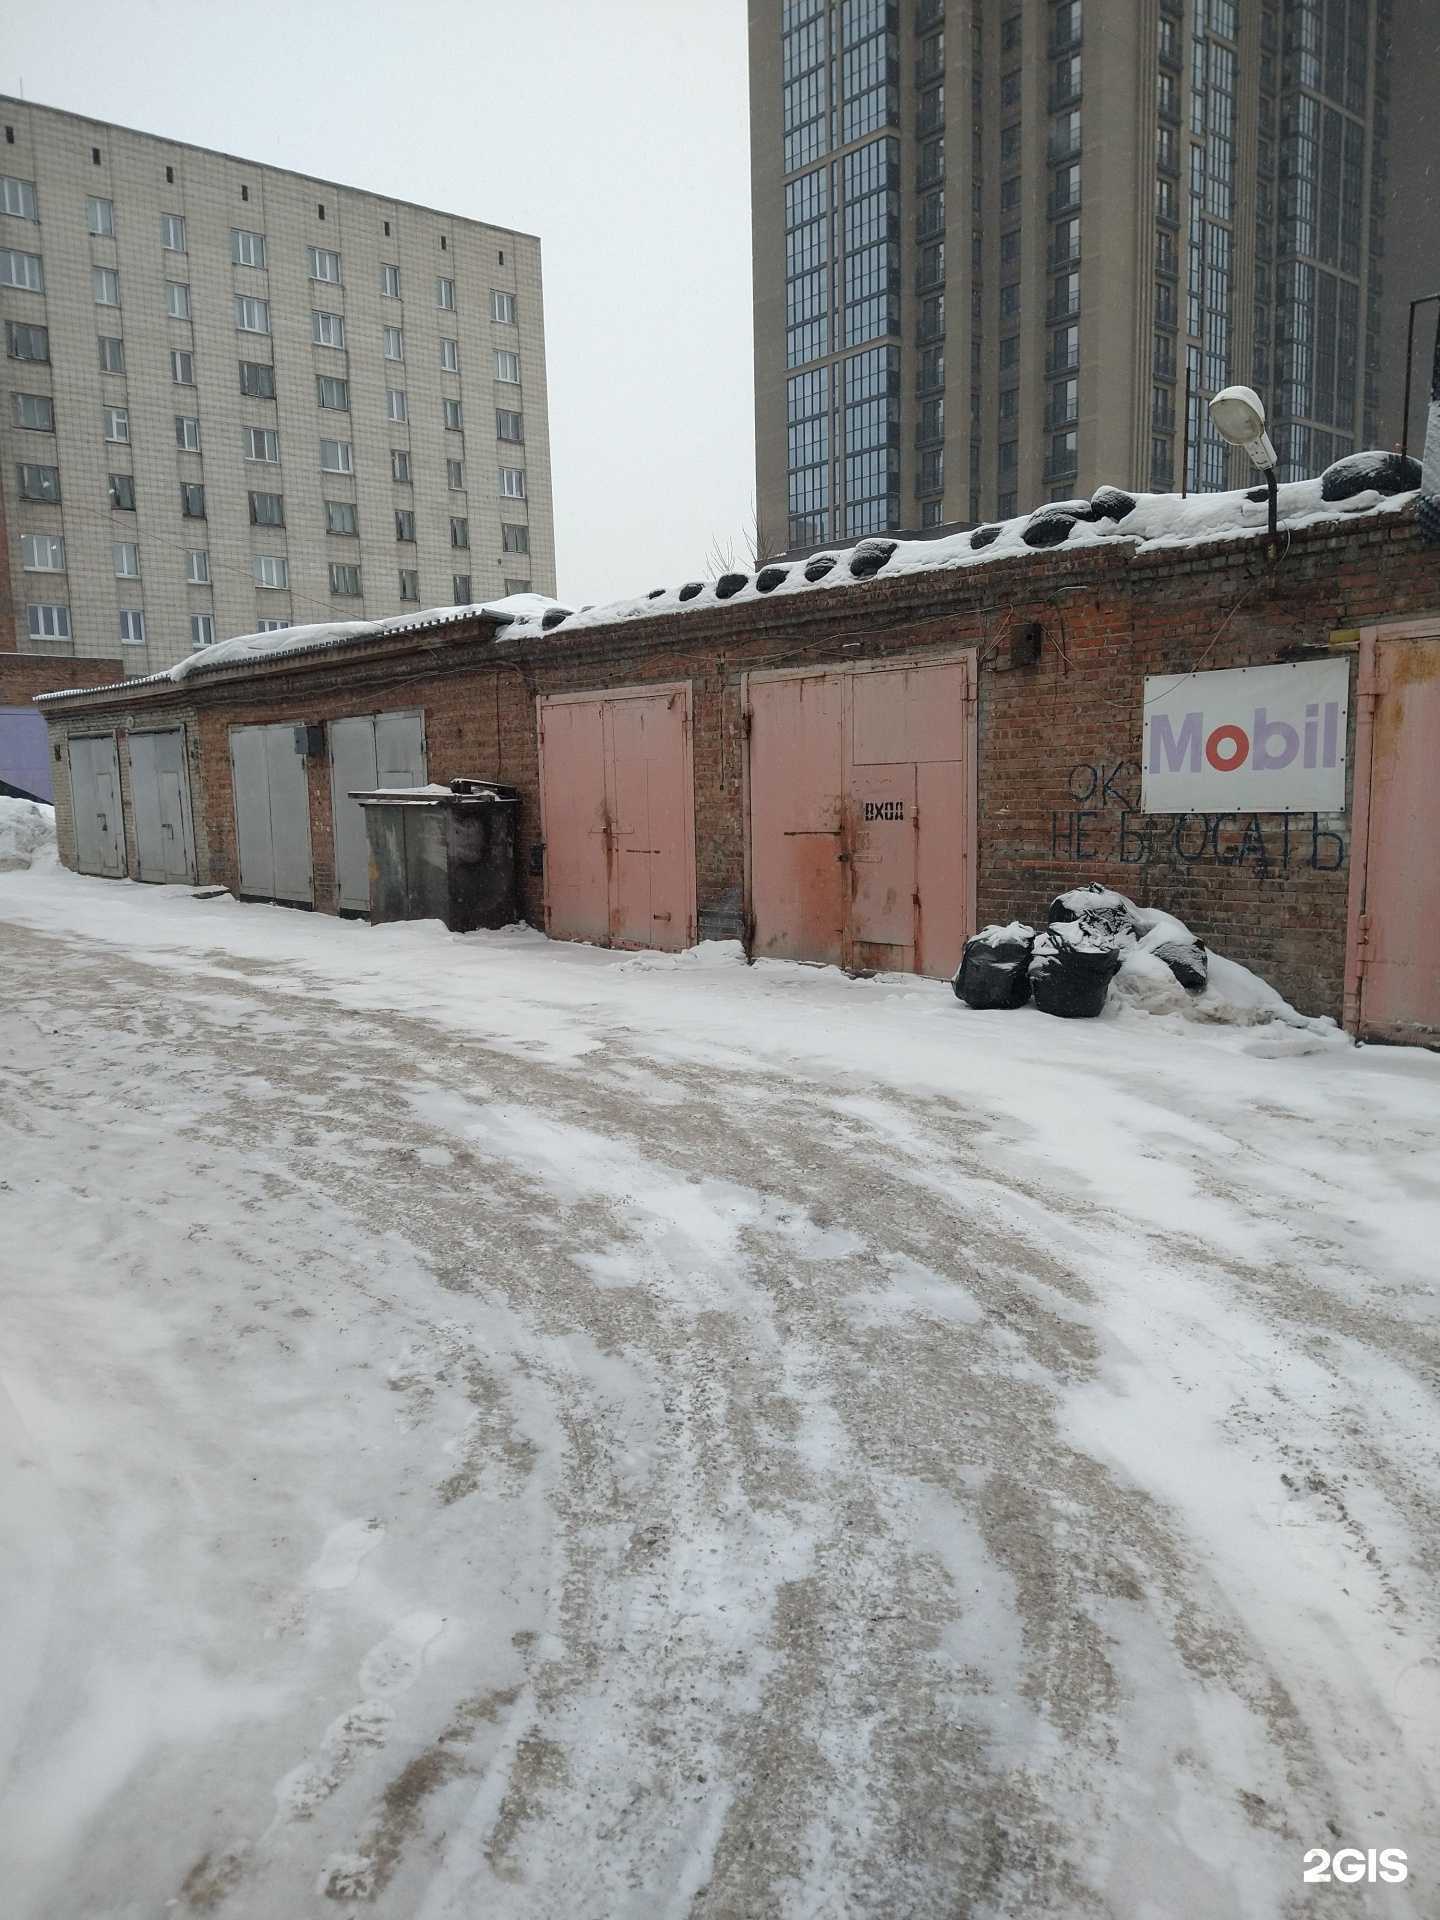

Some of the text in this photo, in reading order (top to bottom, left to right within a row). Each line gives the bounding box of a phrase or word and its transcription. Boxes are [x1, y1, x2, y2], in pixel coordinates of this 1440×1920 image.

[1150, 702, 1339, 774] Mobil
[865, 801, 904, 821] ВХОД
[1052, 811, 1098, 860] НЕ
